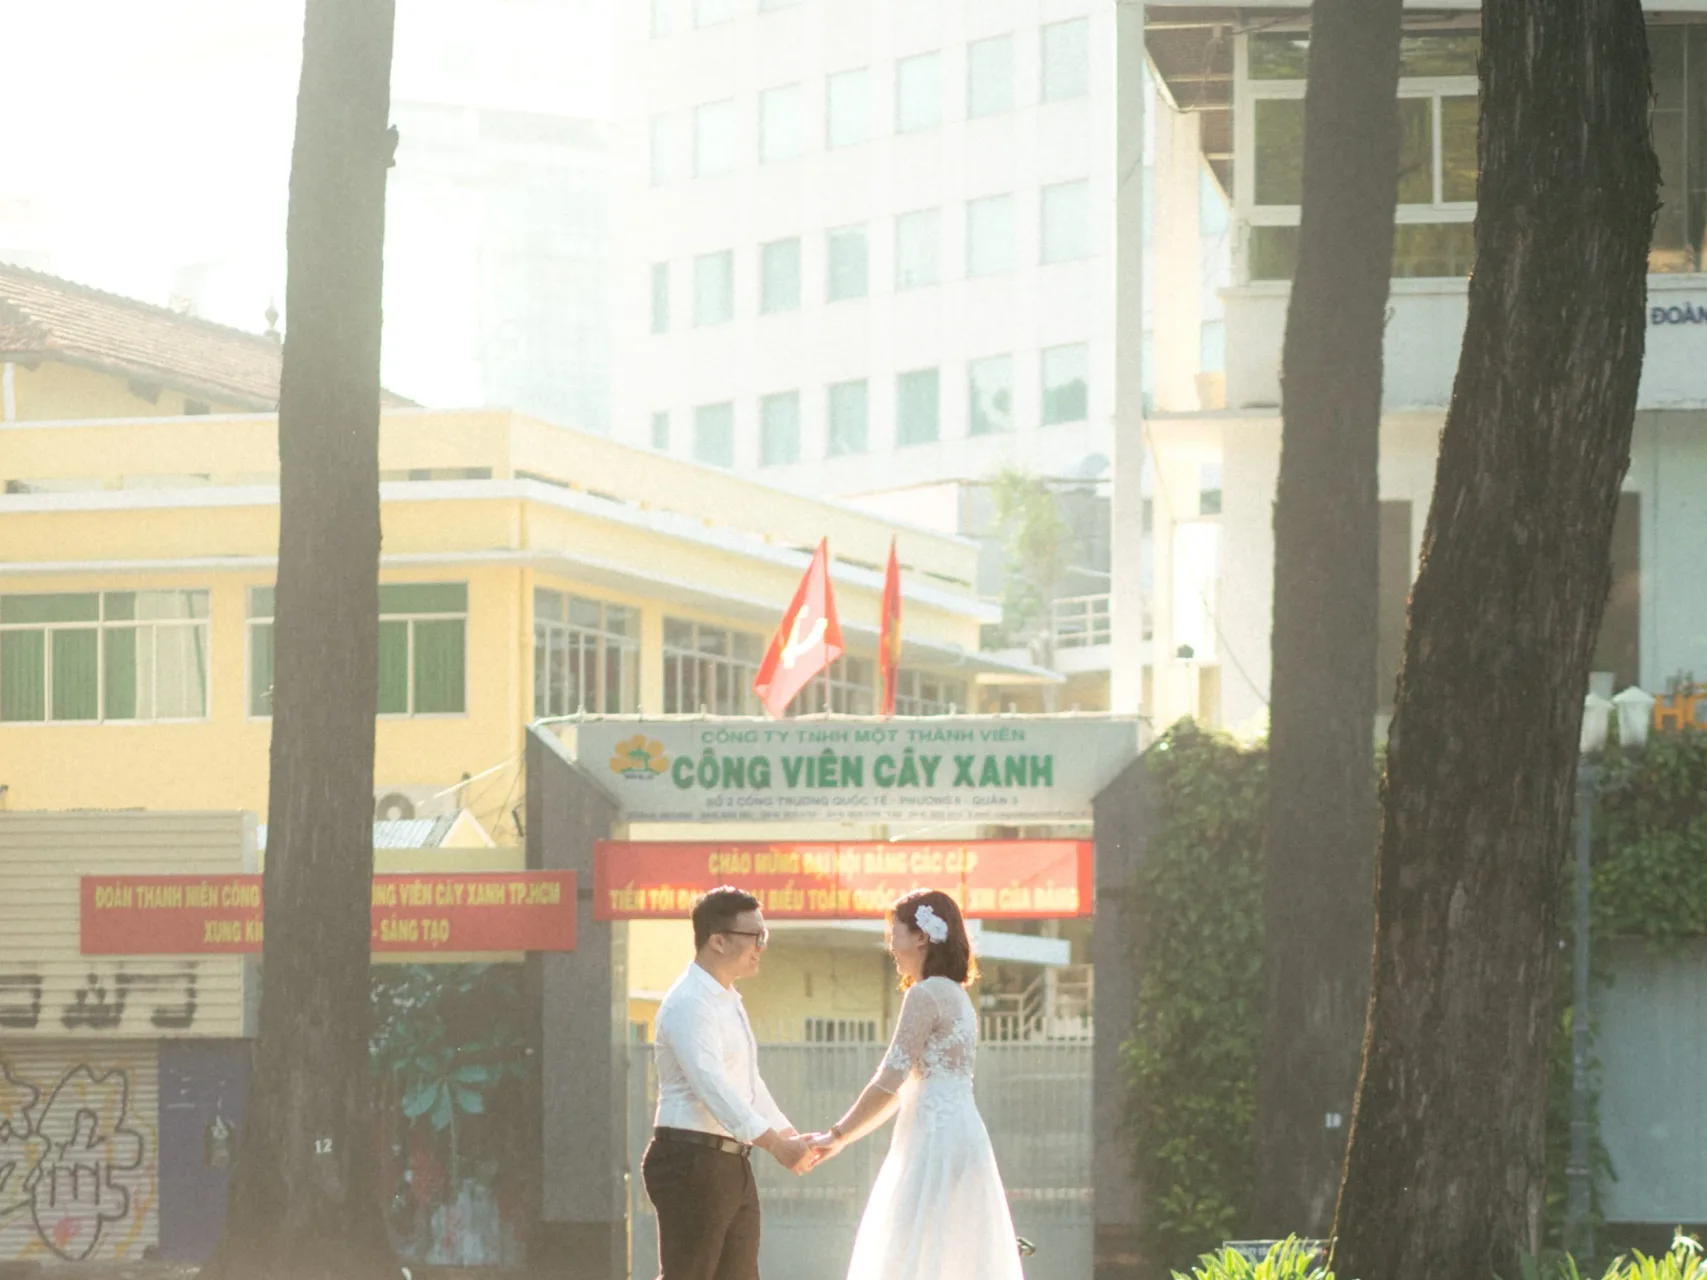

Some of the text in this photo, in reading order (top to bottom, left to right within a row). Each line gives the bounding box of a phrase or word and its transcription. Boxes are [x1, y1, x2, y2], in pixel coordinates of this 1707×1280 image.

[701, 727, 1026, 746] CÔNG TY TNHH MỘT THÀNH VIÊN
[671, 746, 1054, 790] CÔNG VIÊN CÂY XANH
[94, 880, 132, 908] ĐOÀN
[136, 884, 182, 908] THANH
[221, 879, 261, 908] CÔNG
[399, 879, 433, 906] VIÊN
[435, 879, 464, 906] CÂY
[467, 883, 506, 905] XANH
[204, 920, 242, 943] XUNG
[380, 913, 419, 942] SÁNG
[421, 918, 450, 949] TẠO
[315, 1138, 333, 1153] 12
